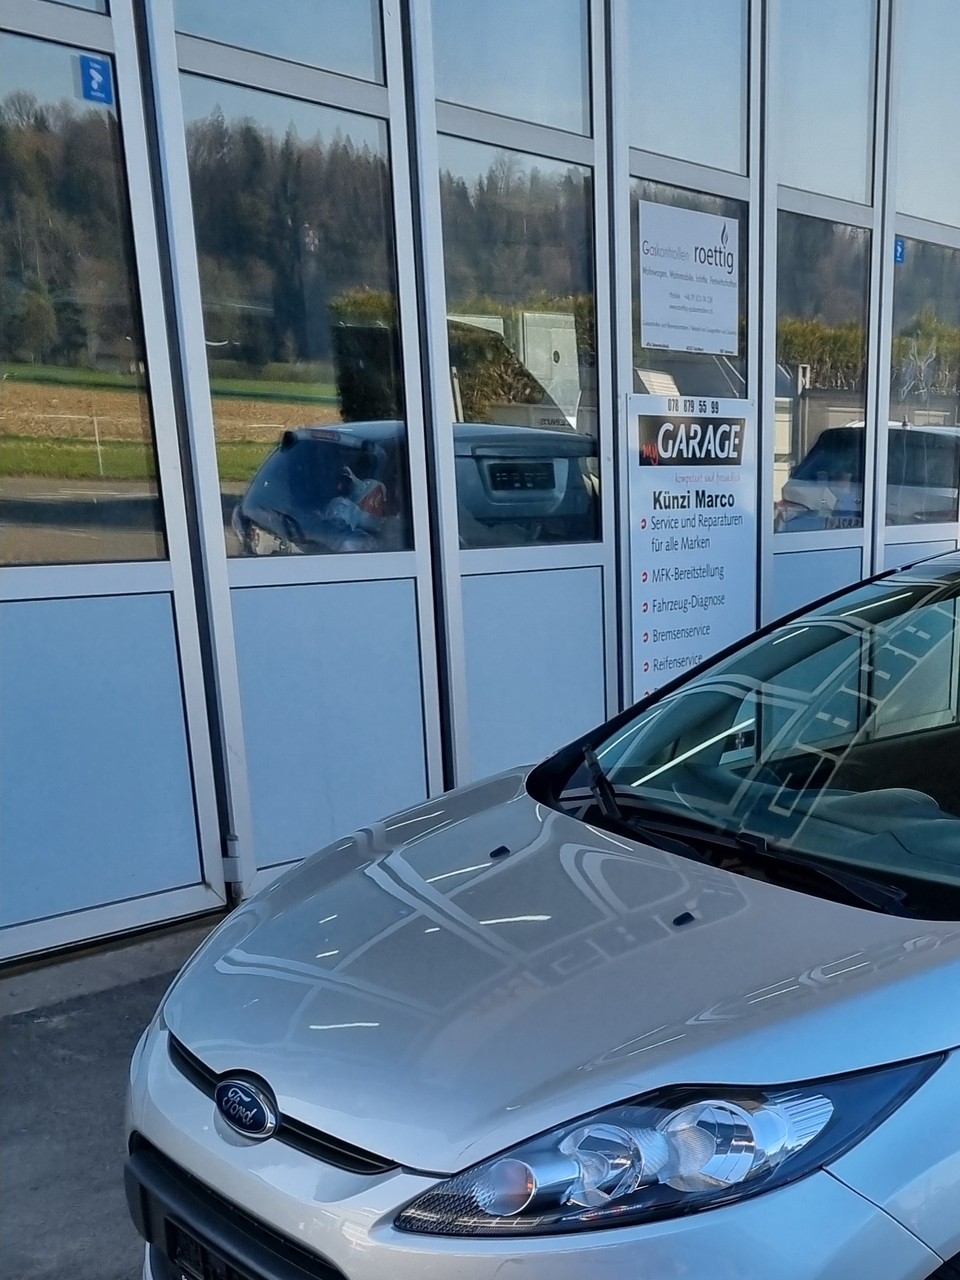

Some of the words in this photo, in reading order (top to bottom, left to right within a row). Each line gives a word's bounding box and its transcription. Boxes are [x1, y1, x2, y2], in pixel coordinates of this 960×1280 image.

[694, 245, 734, 275] roettig
[668, 399, 679, 412] 078
[683, 400, 694, 413] 879
[699, 400, 707, 413] 55
[711, 401, 719, 414] 99
[657, 422, 741, 459] GARAGE
[653, 490, 690, 510] Künzi
[695, 489, 735, 509] Marco
[651, 514, 679, 530] Service
[681, 514, 696, 529] und
[698, 513, 743, 531] Reparaturen
[651, 537, 663, 552] für
[665, 536, 679, 552] alle
[680, 534, 711, 550] Marken
[652, 564, 725, 583] MFK-Bereitstellung
[652, 595, 726, 613] Fahrzeug-Diagnose
[653, 623, 711, 643] Bremsenservice
[653, 653, 703, 672] Reifenservice
[222, 1087, 258, 1125] Ford
